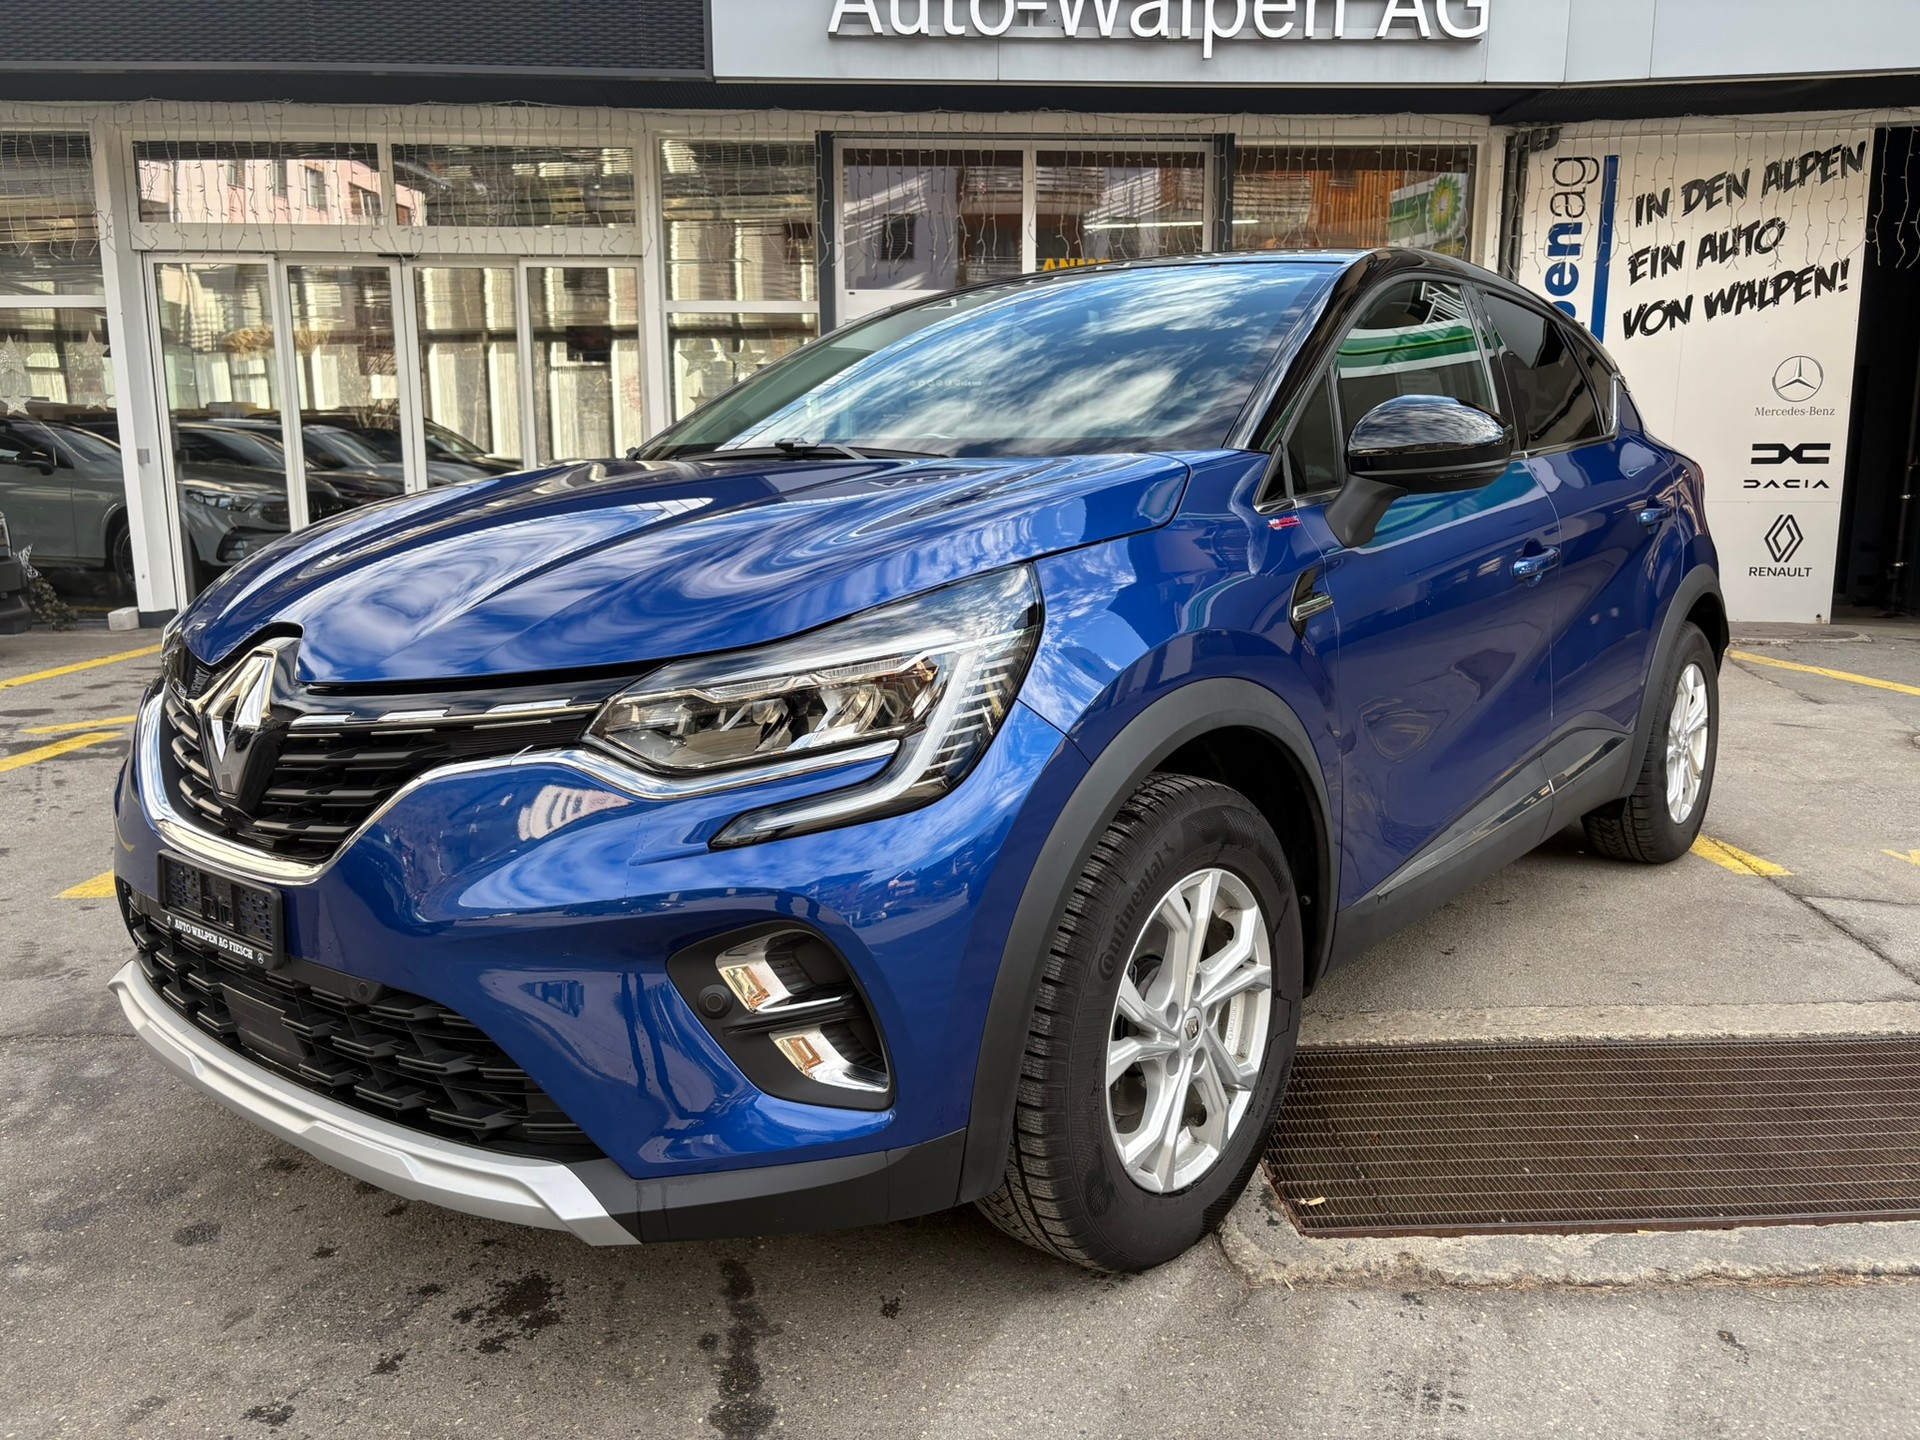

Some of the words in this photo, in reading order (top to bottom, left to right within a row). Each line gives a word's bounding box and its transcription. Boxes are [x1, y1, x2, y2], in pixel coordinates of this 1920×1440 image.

[1635, 187, 1671, 228] IN
[1681, 167, 1750, 218] DEN
[1761, 141, 1866, 199] ALPEN
[1627, 241, 1686, 287] EIN
[1696, 216, 1788, 270] AUTO
[1622, 294, 1693, 340] VON
[1704, 258, 1851, 322] WALPEN!
[1754, 406, 1836, 417] Mercedes-Benz
[1743, 479, 1830, 489] DACIA
[1748, 566, 1813, 578] RENAULT
[174, 920, 192, 933] AUTO
[192, 926, 218, 946] WALPEN
[1098, 850, 1167, 982] Continental
